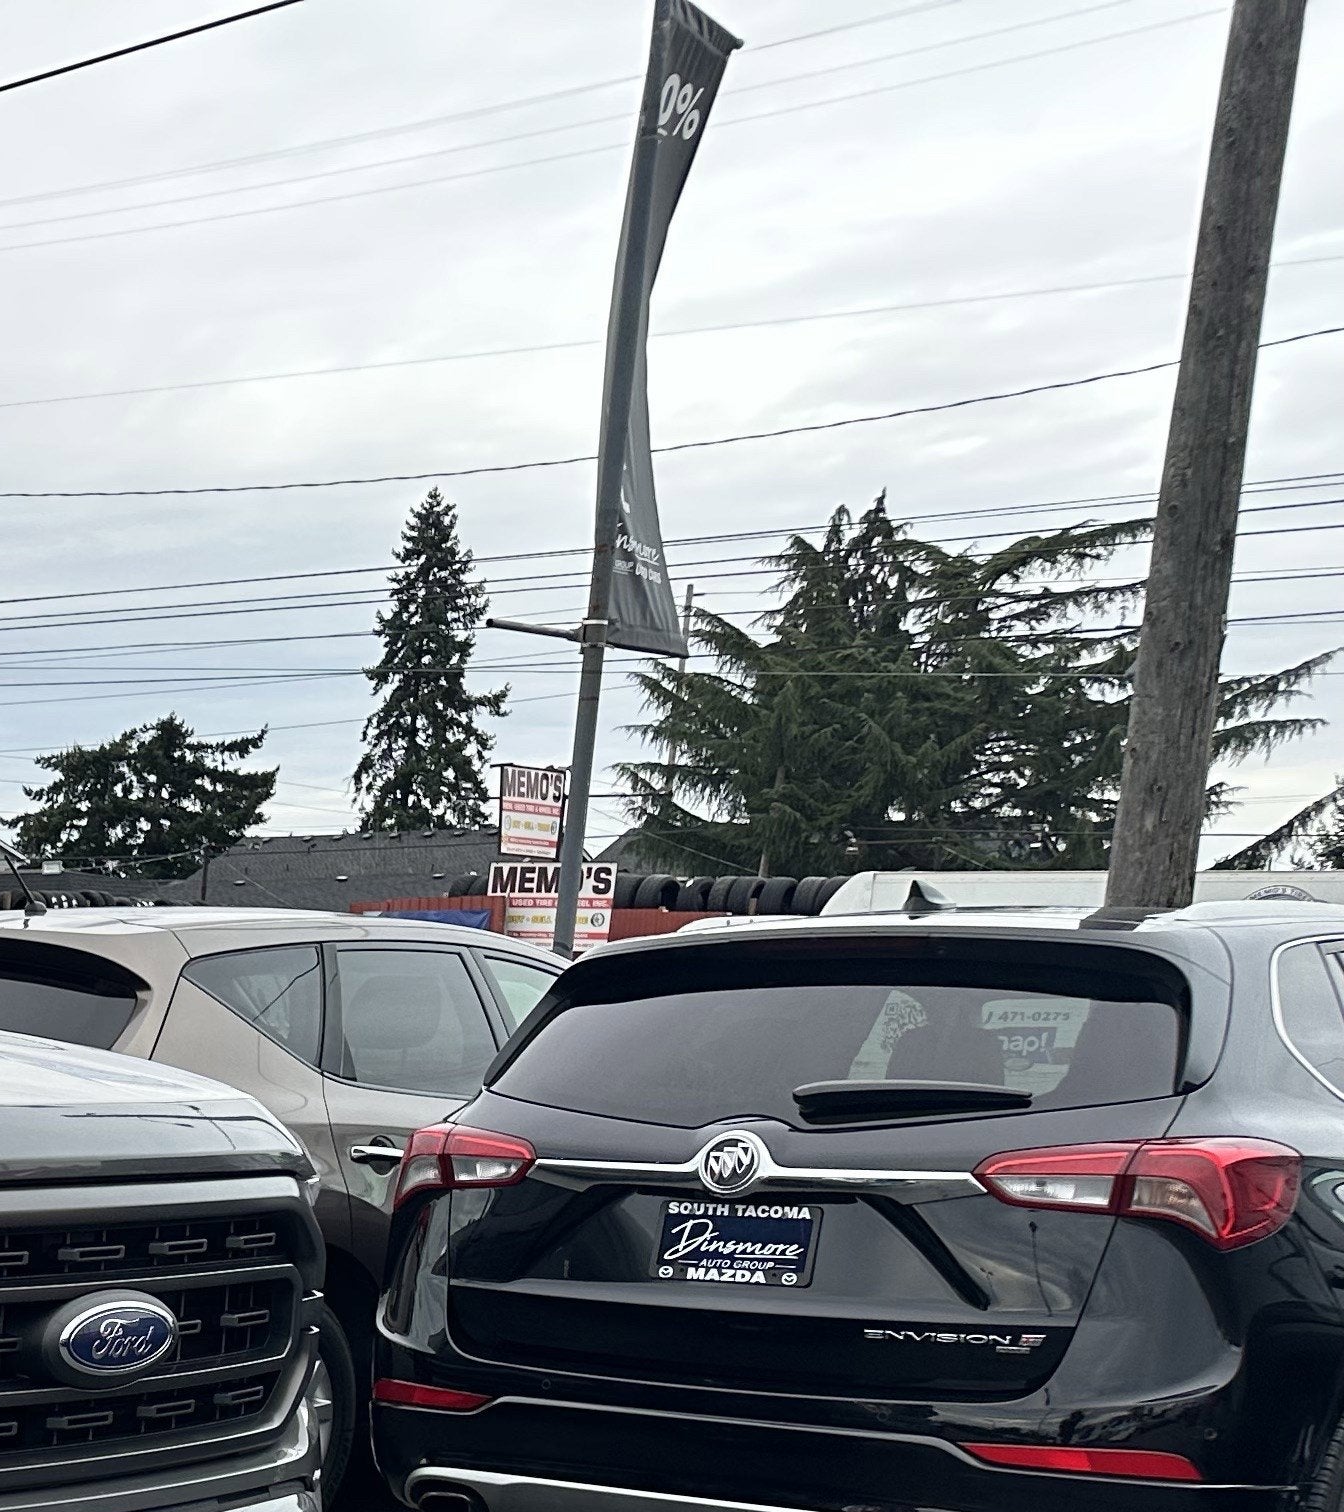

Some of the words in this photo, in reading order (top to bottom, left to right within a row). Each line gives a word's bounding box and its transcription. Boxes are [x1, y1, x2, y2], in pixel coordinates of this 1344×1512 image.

[503, 767, 562, 804] MEMO'S
[491, 866, 612, 895] MEM'S
[668, 1201, 730, 1217] SOUTH
[734, 1204, 811, 1220] TACOMA
[663, 1218, 805, 1261] Dinsmore
[686, 1267, 767, 1284] MAZDA
[698, 1258, 731, 1269] AUTO
[733, 1259, 775, 1271] GROUP
[92, 1317, 155, 1360] Ford
[863, 1328, 1012, 1346] ENVISION
